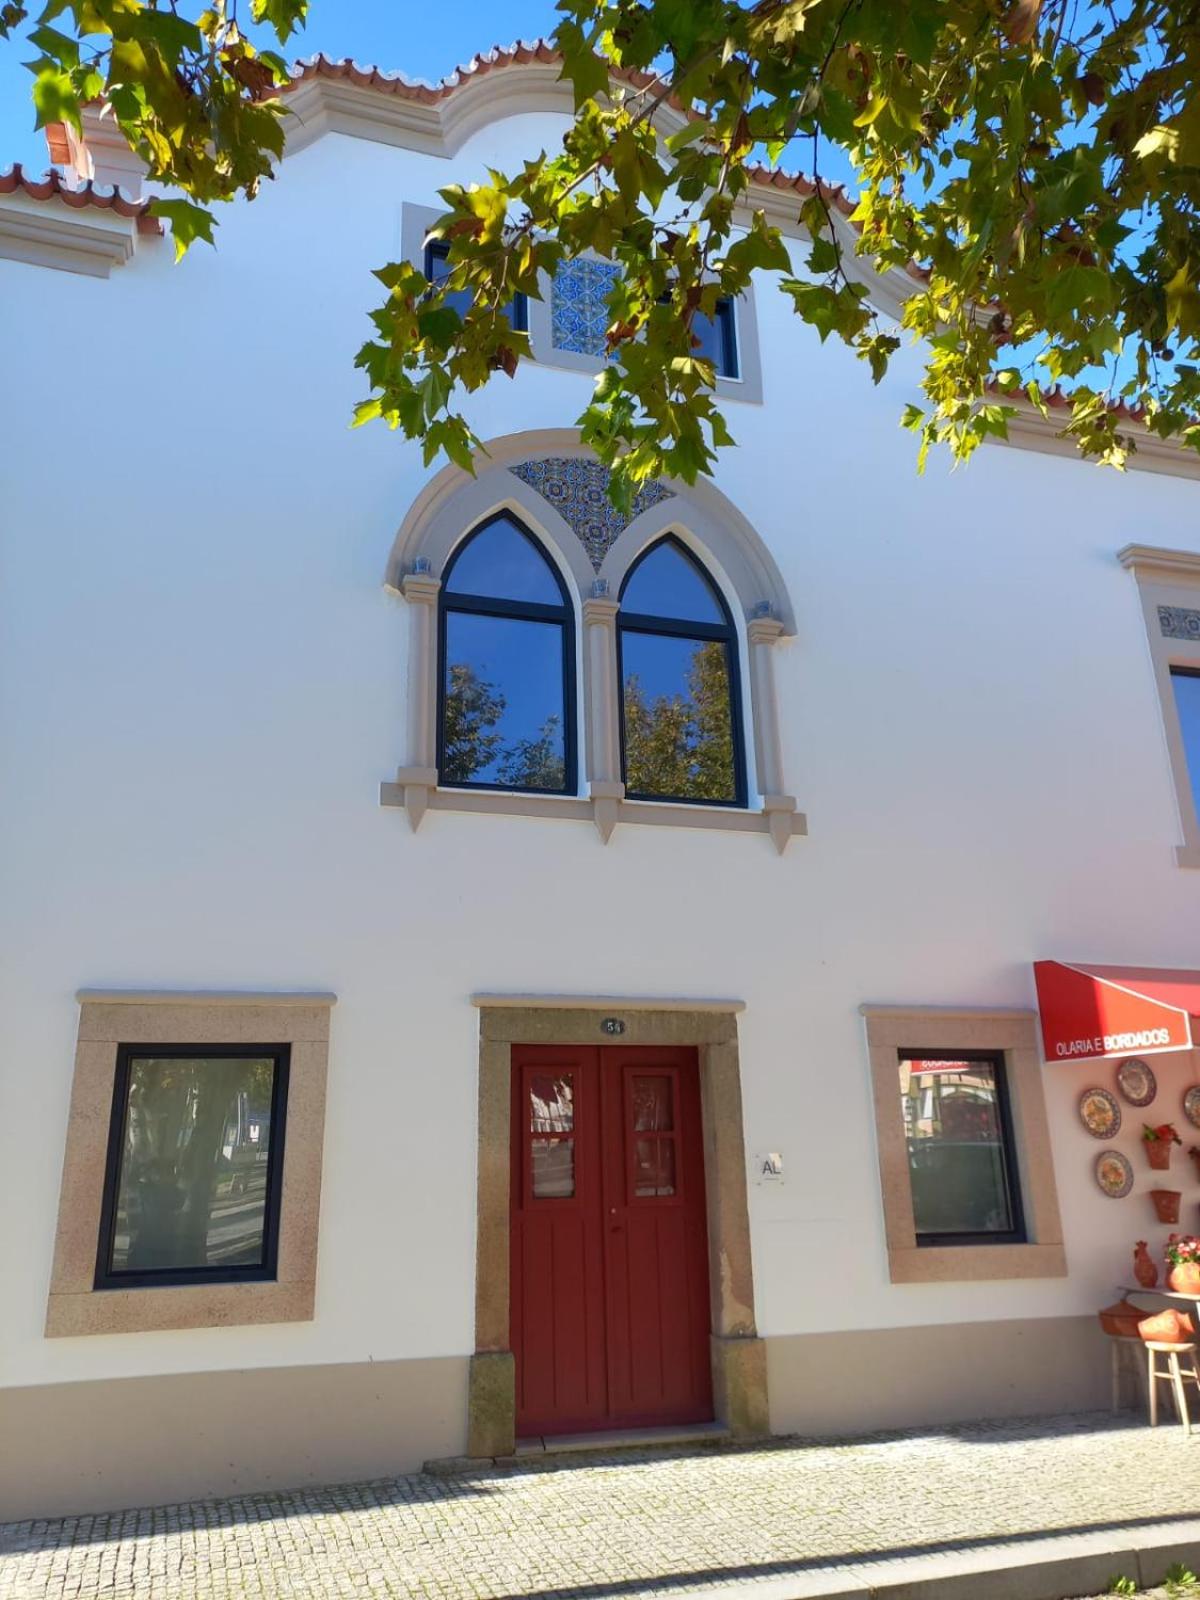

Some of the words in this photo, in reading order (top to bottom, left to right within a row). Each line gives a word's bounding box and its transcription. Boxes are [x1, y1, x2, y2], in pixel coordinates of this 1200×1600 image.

[1056, 1039, 1093, 1056] OLARIA
[1095, 1038, 1103, 1051] E
[1104, 1028, 1169, 1051] BORDADOS
[762, 1160, 781, 1175] AL
